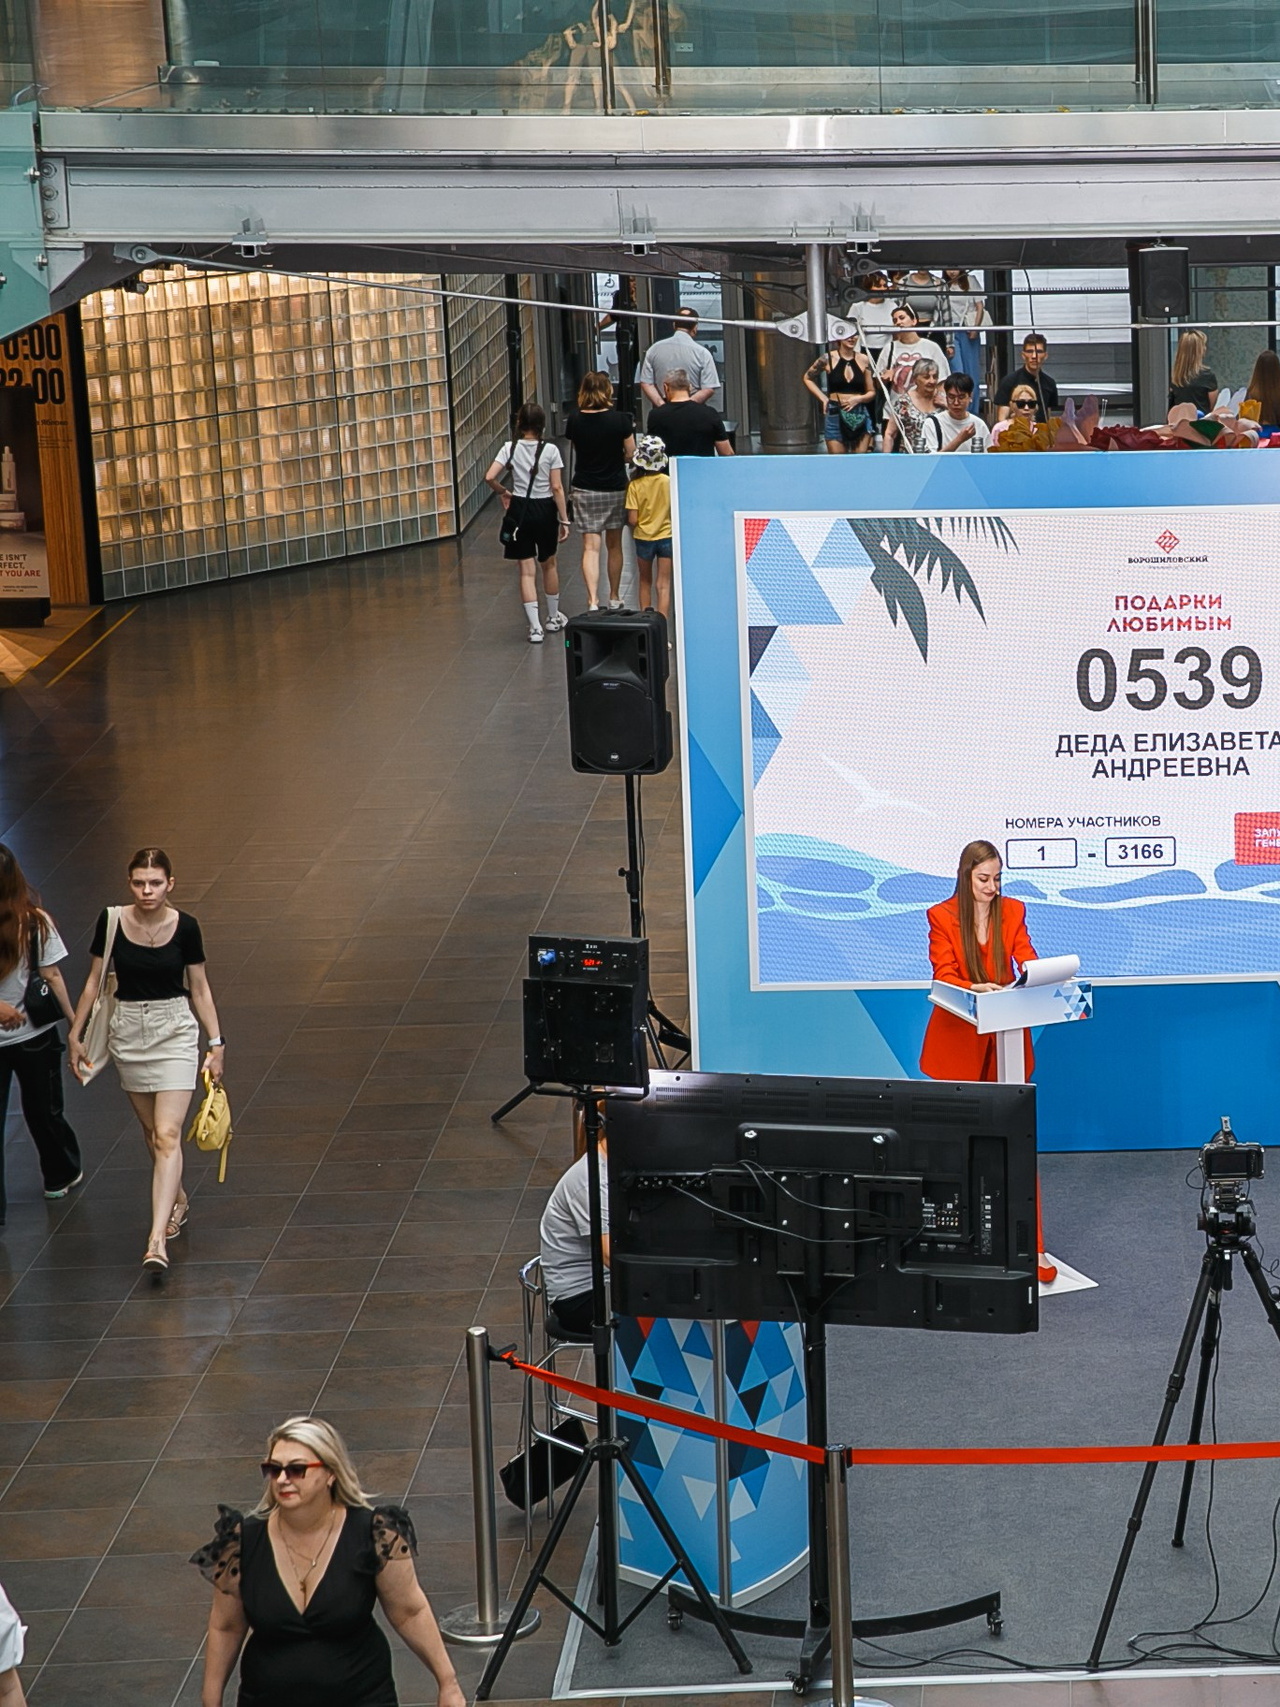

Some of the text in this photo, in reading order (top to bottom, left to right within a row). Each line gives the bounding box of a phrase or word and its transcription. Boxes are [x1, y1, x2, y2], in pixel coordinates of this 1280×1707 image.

[6, 553, 27, 562] ISN'T
[1128, 555, 1208, 564] ВОРОШИЛОВСКИЙ
[5, 570, 22, 578] YOU
[24, 570, 41, 578] ARE
[1115, 594, 1222, 612] ПОДАРКИ
[1106, 615, 1231, 632] ЛЮБИМЫМ
[1076, 645, 1263, 711] 0539
[1055, 734, 1126, 757] ДЕДА
[1091, 757, 1251, 781] АНДРЕЕВНА
[1005, 815, 1161, 829] НОМЕРА УЧАСТНИКОВ
[1037, 845, 1046, 861] 1
[1118, 843, 1164, 860] 3166
